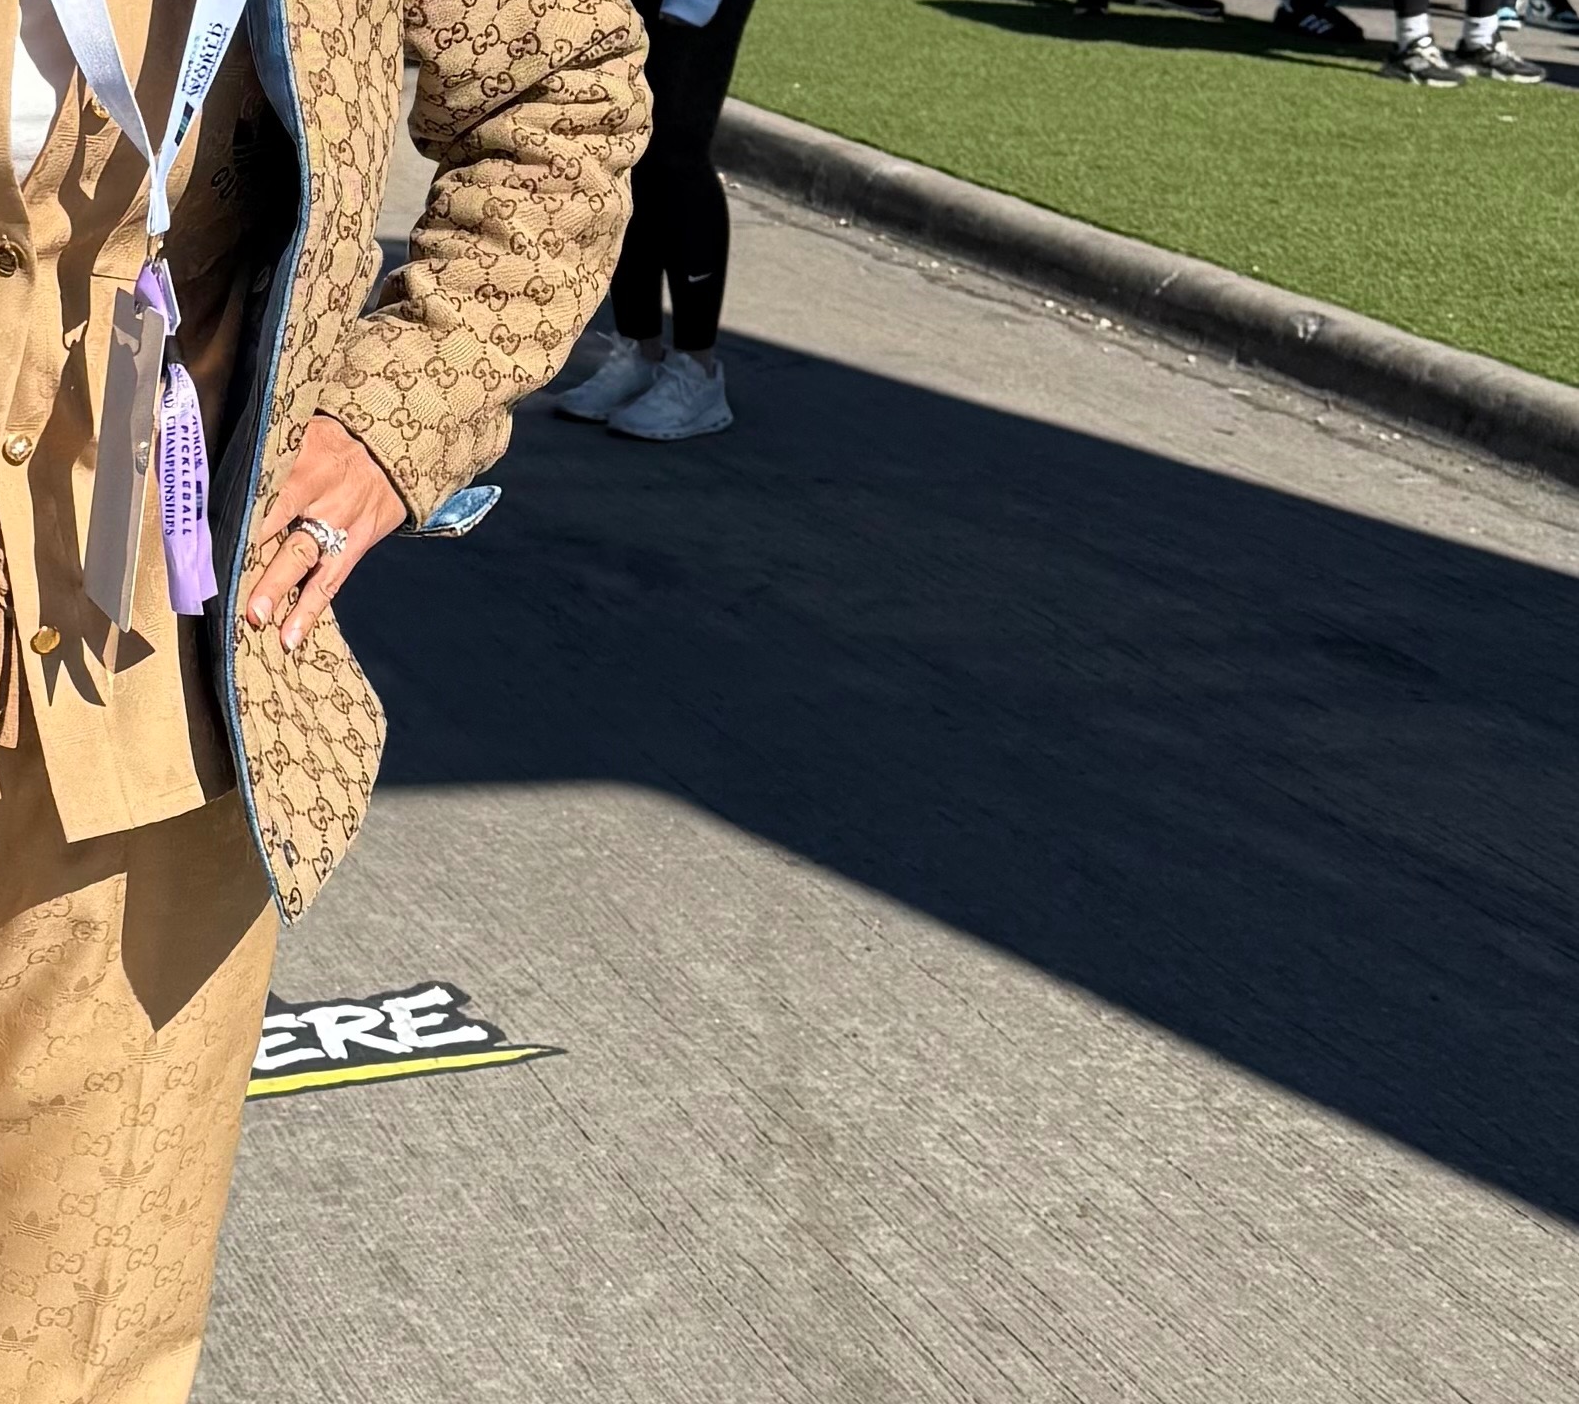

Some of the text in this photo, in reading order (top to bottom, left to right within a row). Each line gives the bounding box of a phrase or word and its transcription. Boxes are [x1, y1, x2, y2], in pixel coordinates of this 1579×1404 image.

[186, 22, 223, 97] WORLD
[164, 414, 177, 538] CHAMPIONSHIPS
[180, 424, 192, 537] PICKLEBALL
[251, 985, 489, 1071] ERE
